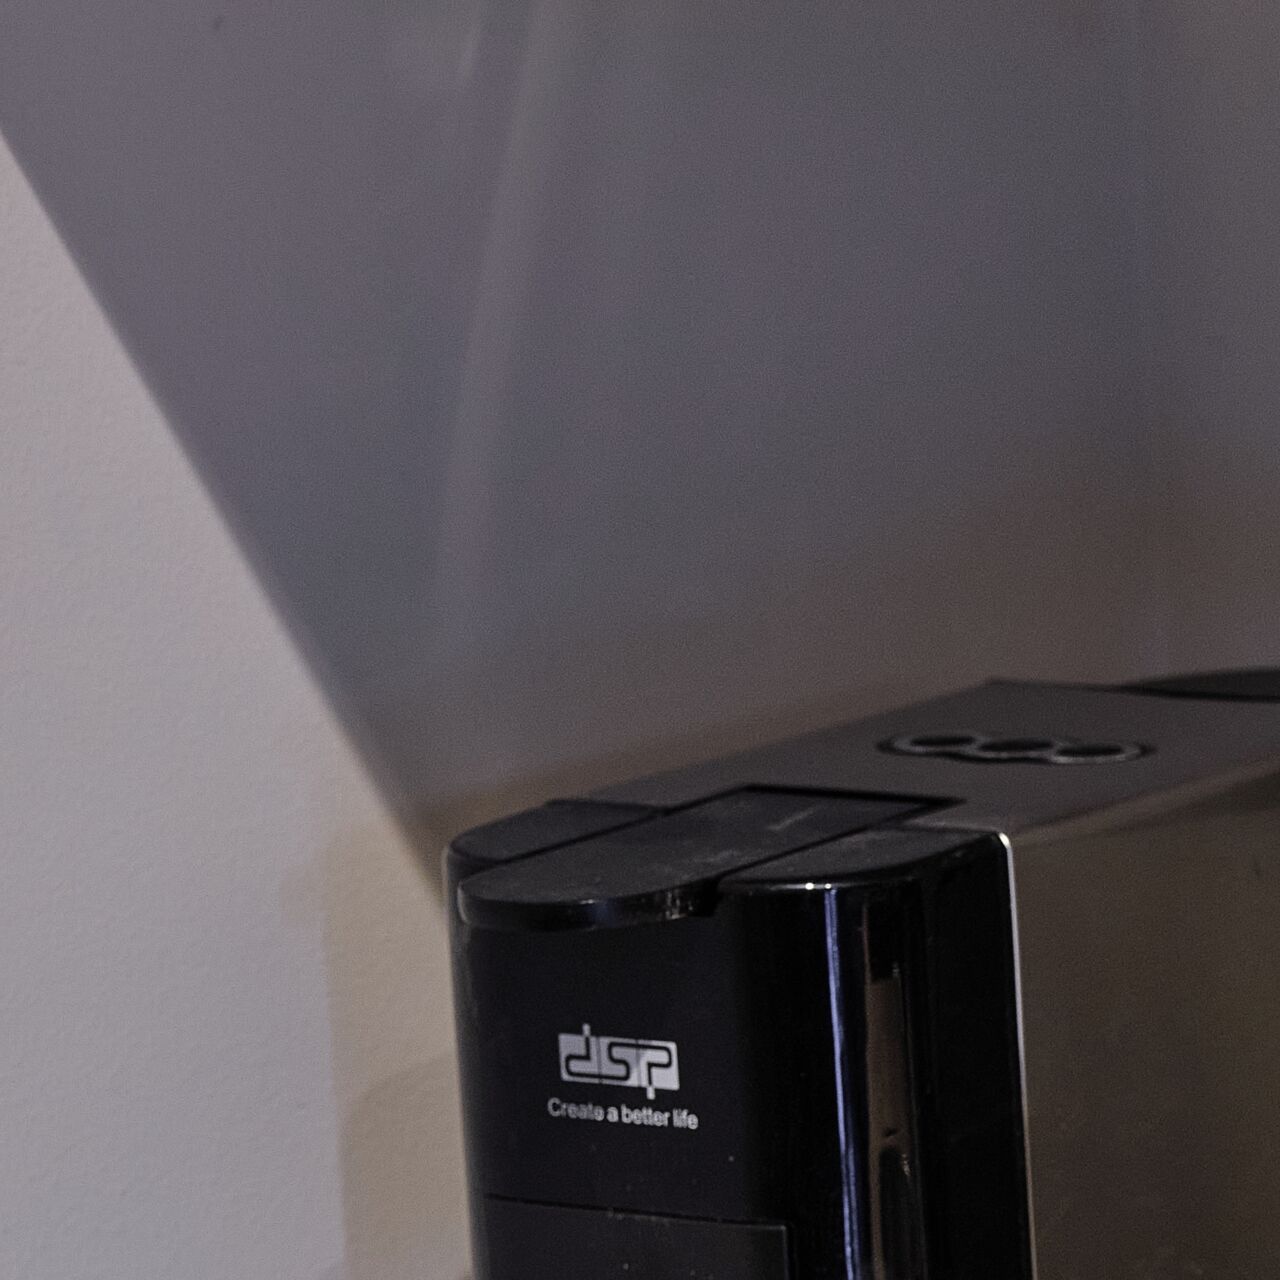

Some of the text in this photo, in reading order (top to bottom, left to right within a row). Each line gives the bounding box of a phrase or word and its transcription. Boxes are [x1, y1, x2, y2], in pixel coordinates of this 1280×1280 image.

[547, 1097, 699, 1130] Create a better life
